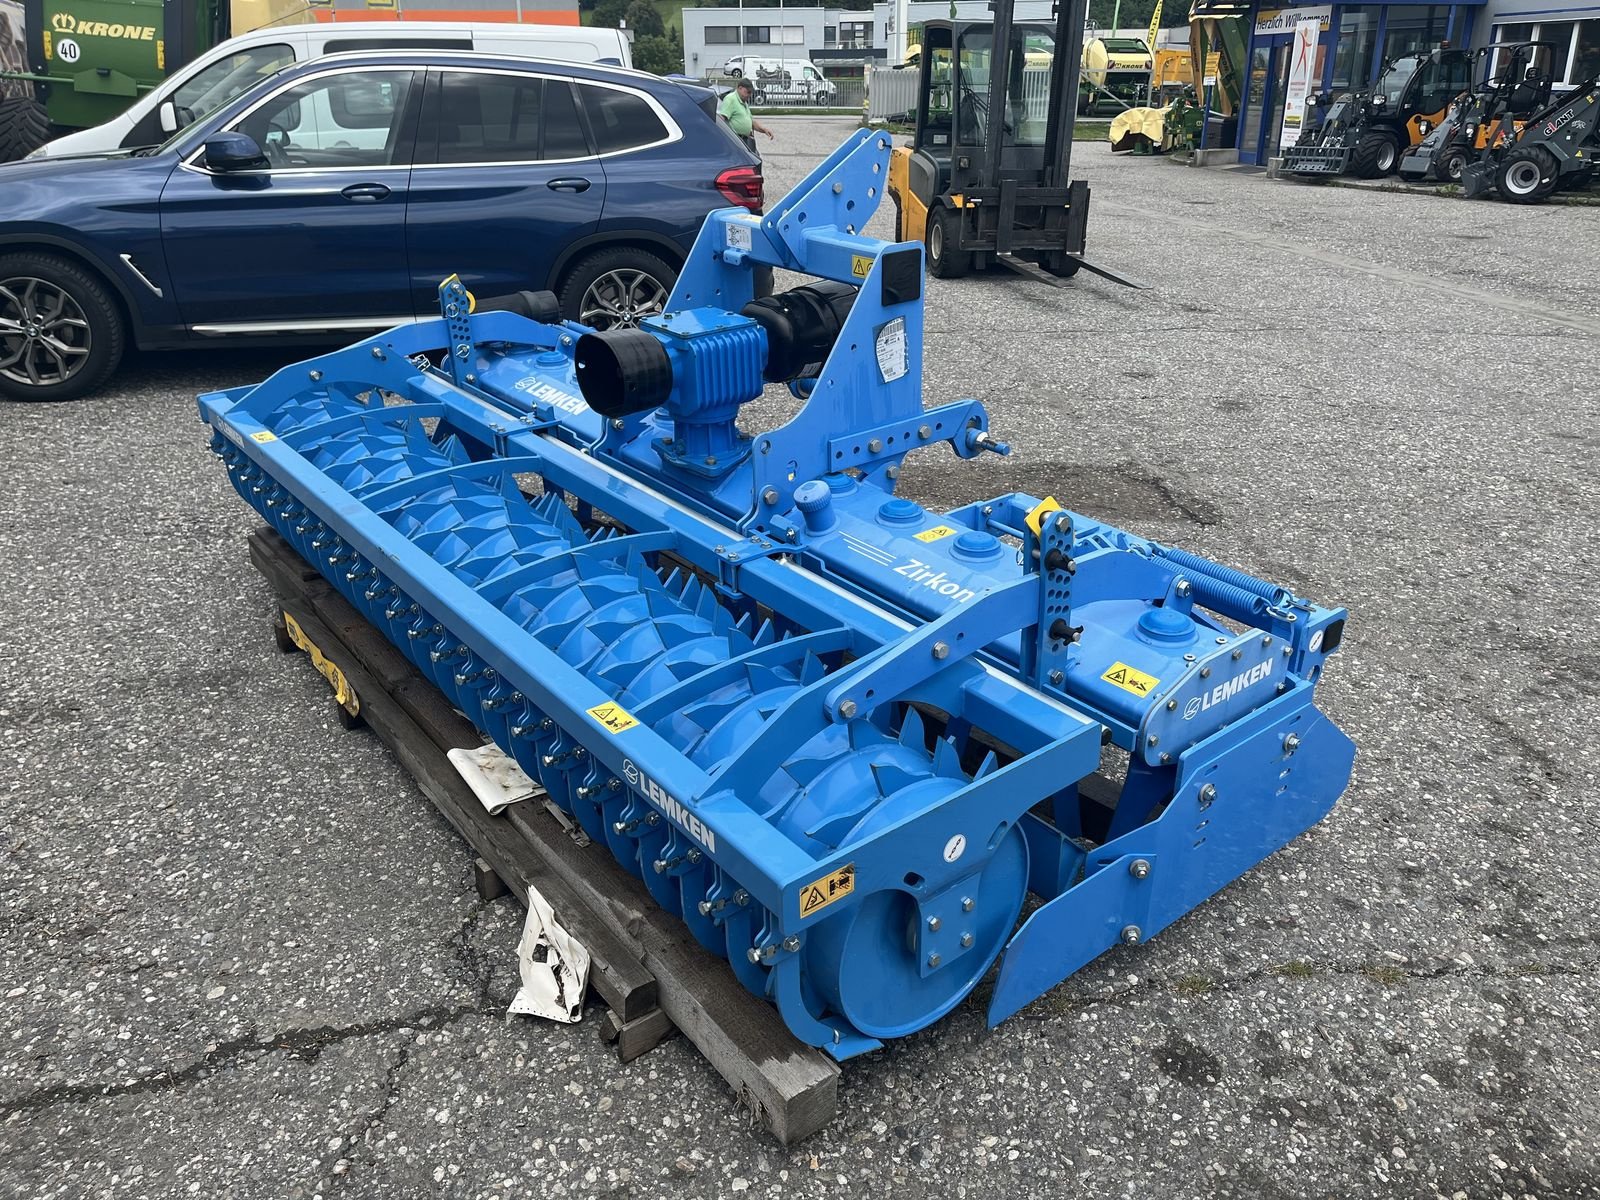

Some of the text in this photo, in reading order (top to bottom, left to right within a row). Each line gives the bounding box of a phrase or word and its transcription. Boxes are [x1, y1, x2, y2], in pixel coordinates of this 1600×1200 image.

[77, 20, 156, 41] KRONE
[1256, 14, 1283, 30] Herzlich
[60, 42, 77, 59] 40
[525, 381, 589, 416] LEMKEN
[892, 558, 976, 603] Zirkon
[1201, 657, 1273, 712] LEMKEN
[640, 771, 716, 854] LEMKEN
